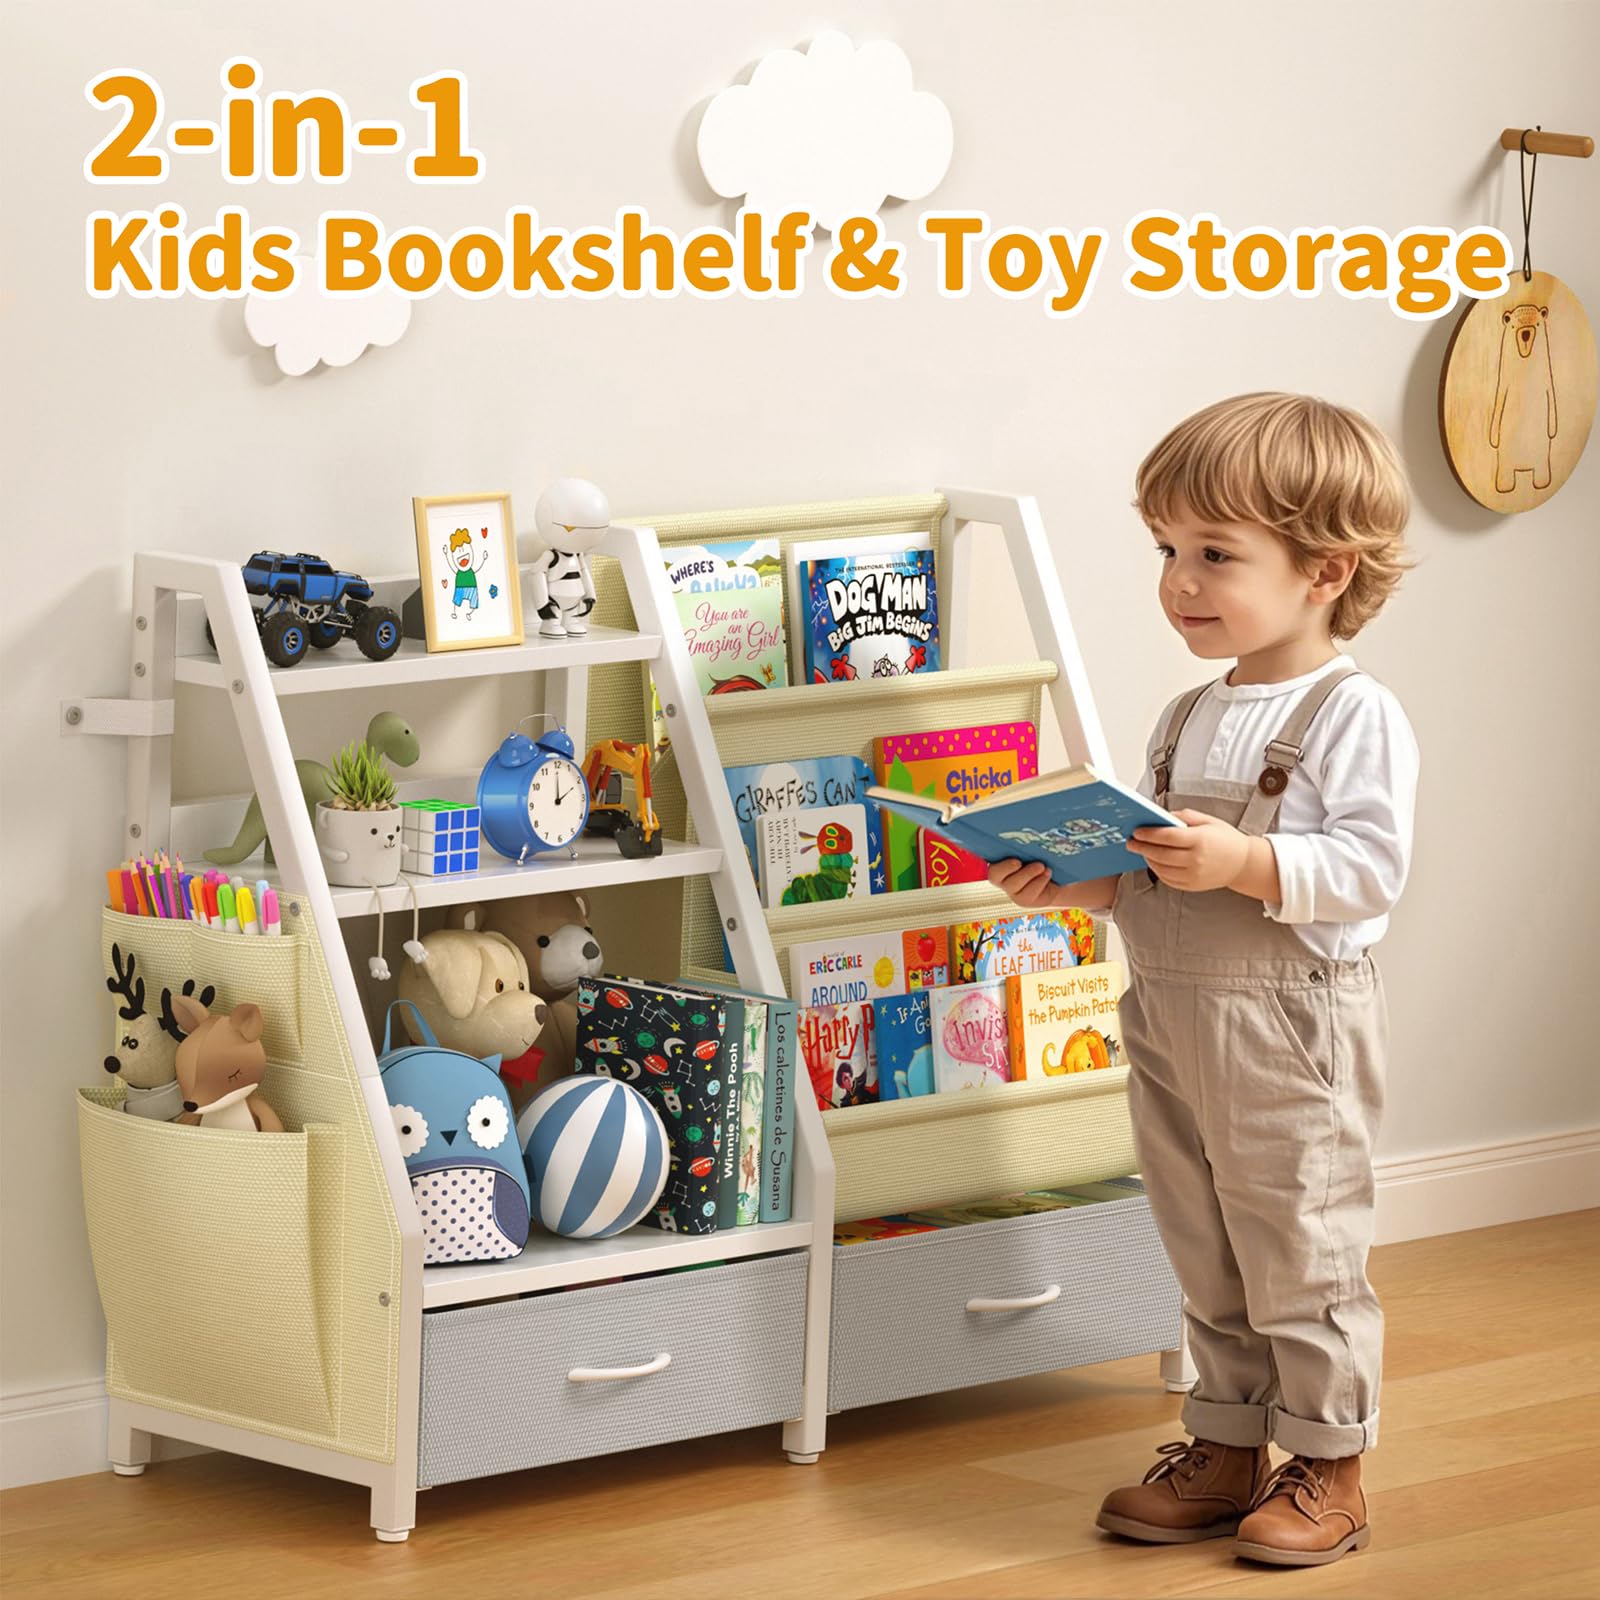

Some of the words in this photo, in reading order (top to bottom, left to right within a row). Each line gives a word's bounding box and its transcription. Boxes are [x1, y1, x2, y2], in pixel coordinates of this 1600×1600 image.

[670, 560, 715, 585] WHERE'S
[825, 574, 878, 622] DOG
[880, 572, 927, 612] MAN
[695, 601, 729, 632] You
[731, 608, 749, 620] are
[728, 624, 742, 634] an
[746, 620, 780, 660] Girl
[541, 768, 549, 776] 11
[553, 760, 562, 769] 12
[532, 783, 541, 791] 10
[946, 766, 1012, 794] Chicka
[529, 802, 534, 811] 9
[735, 778, 818, 823] GIRAFFES
[823, 769, 870, 807] CAN'T
[534, 820, 539, 828] 8
[544, 832, 549, 840] 7
[557, 834, 562, 842] 6
[1017, 938, 1033, 952] the
[835, 954, 863, 972] CARLE
[994, 954, 1024, 977] LEAF
[1028, 949, 1064, 974] THIEF
[811, 981, 868, 1008] AROUND
[1037, 978, 1076, 1002] Biscuit
[1077, 975, 1109, 994] Visits
[1029, 1007, 1047, 1025] the
[1048, 1001, 1091, 1023] Pumpkin
[775, 1011, 791, 1043] Los
[803, 1011, 860, 1061] Harry
[727, 1042, 739, 1085] Pooh
[774, 1046, 789, 1122] calcetines
[726, 1089, 736, 1120] The
[774, 1126, 787, 1145] de
[724, 1123, 736, 1179] Winnie
[771, 1150, 787, 1211] Susana
